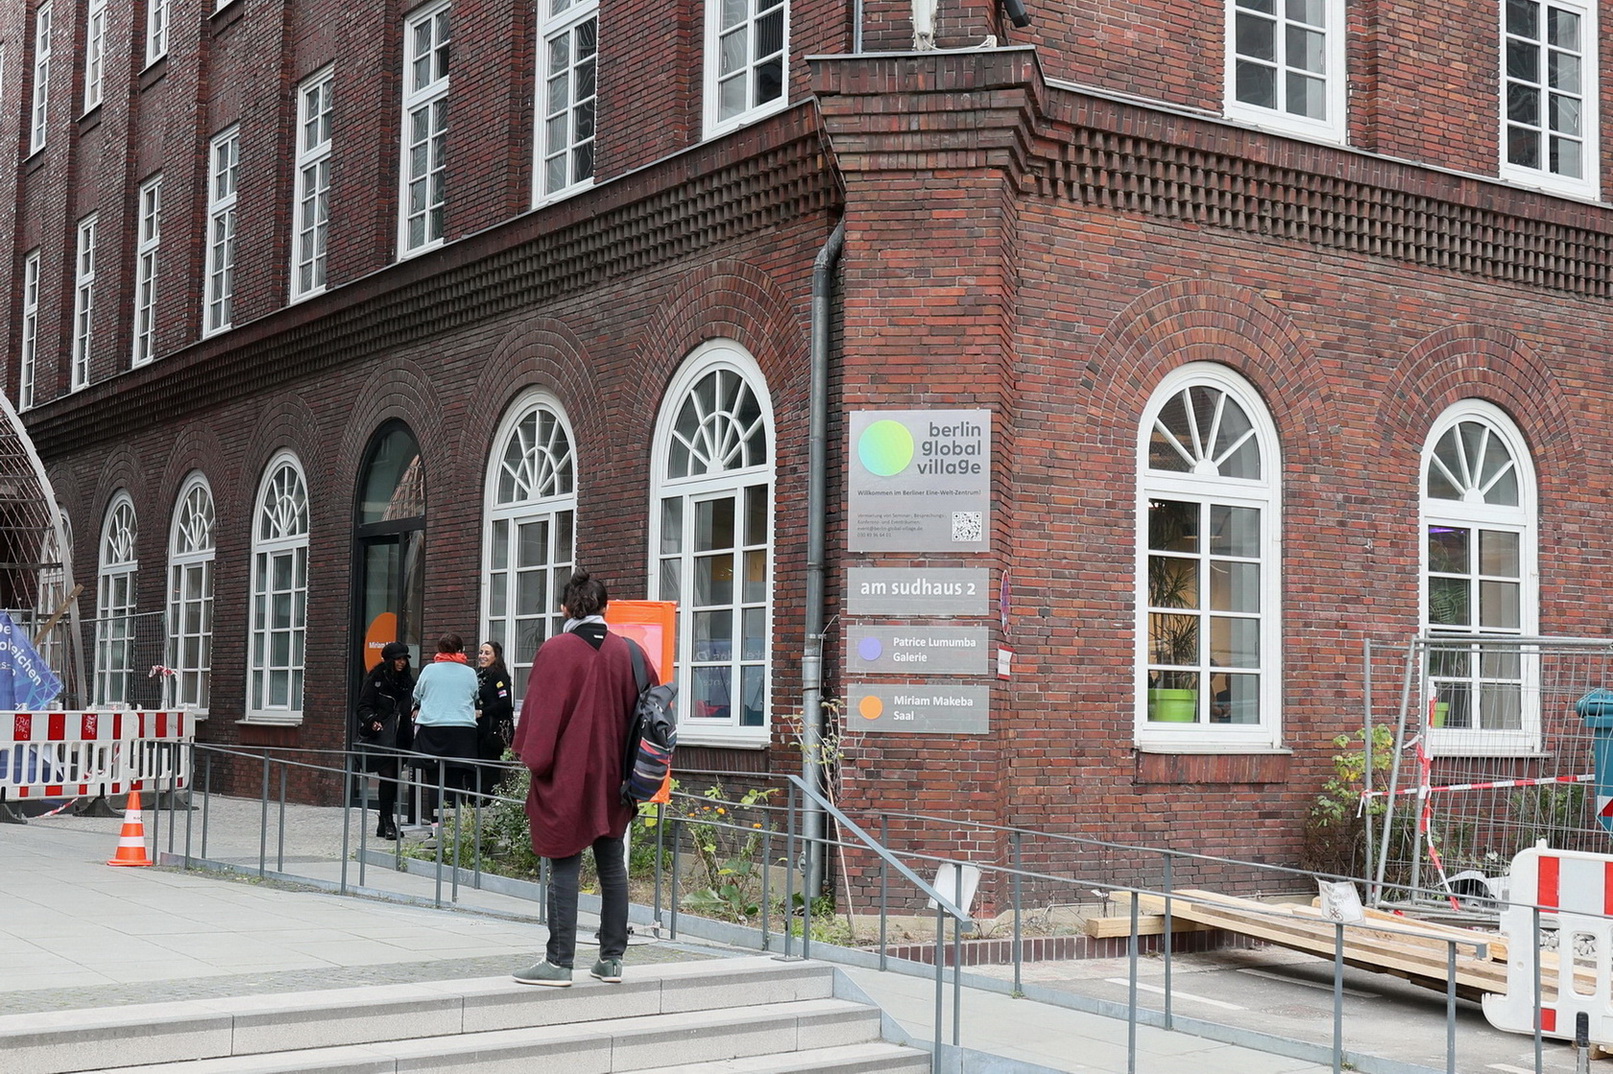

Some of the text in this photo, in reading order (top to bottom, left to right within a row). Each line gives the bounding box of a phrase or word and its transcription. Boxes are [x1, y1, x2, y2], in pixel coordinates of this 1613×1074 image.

[929, 421, 981, 437] berlin
[921, 440, 981, 456] global
[917, 459, 981, 474] village
[857, 489, 893, 497] Willkommen
[860, 578, 976, 595] am sudhaus 2
[893, 637, 976, 647] Patrice Lumumba
[893, 652, 927, 662] Galerie
[894, 695, 973, 707] Miriam Makeba
[893, 711, 914, 721] Saal
